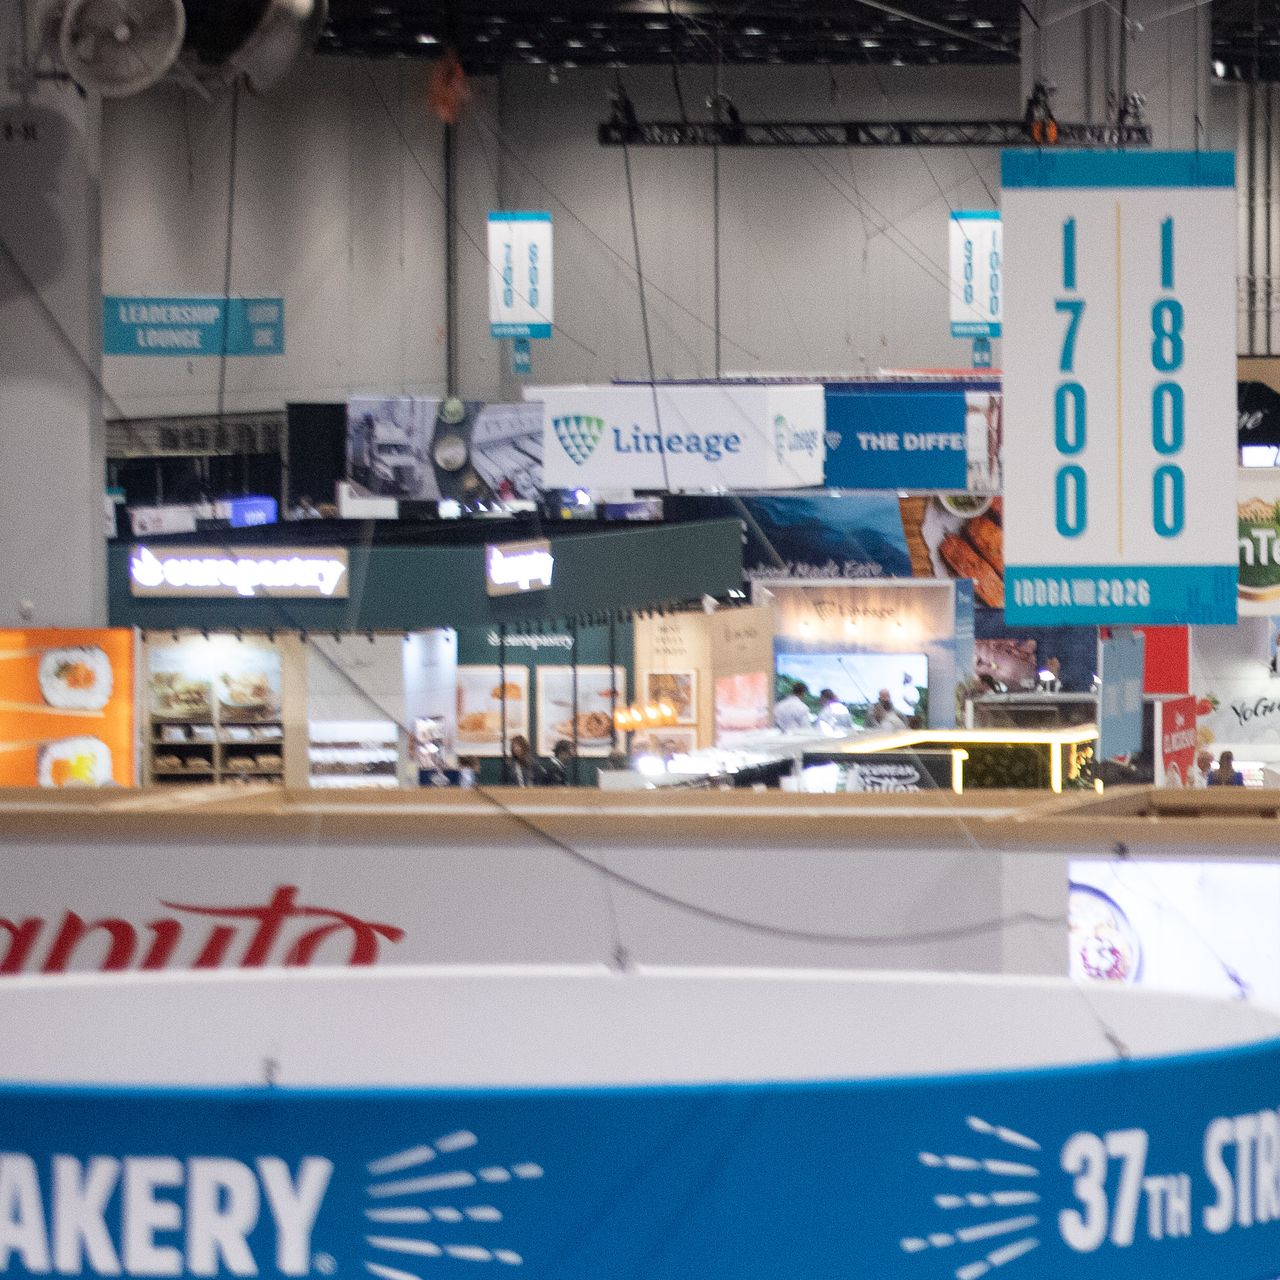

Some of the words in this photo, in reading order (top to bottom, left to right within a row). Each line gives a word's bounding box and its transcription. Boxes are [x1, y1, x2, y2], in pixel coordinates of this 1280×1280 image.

[1054, 216, 1087, 537] 1700
[1150, 216, 1185, 537] 1800
[611, 425, 741, 461] Lineage
[857, 432, 897, 451] THE
[903, 432, 967, 451] DIFFE
[0, 1152, 334, 1276] AKERY
